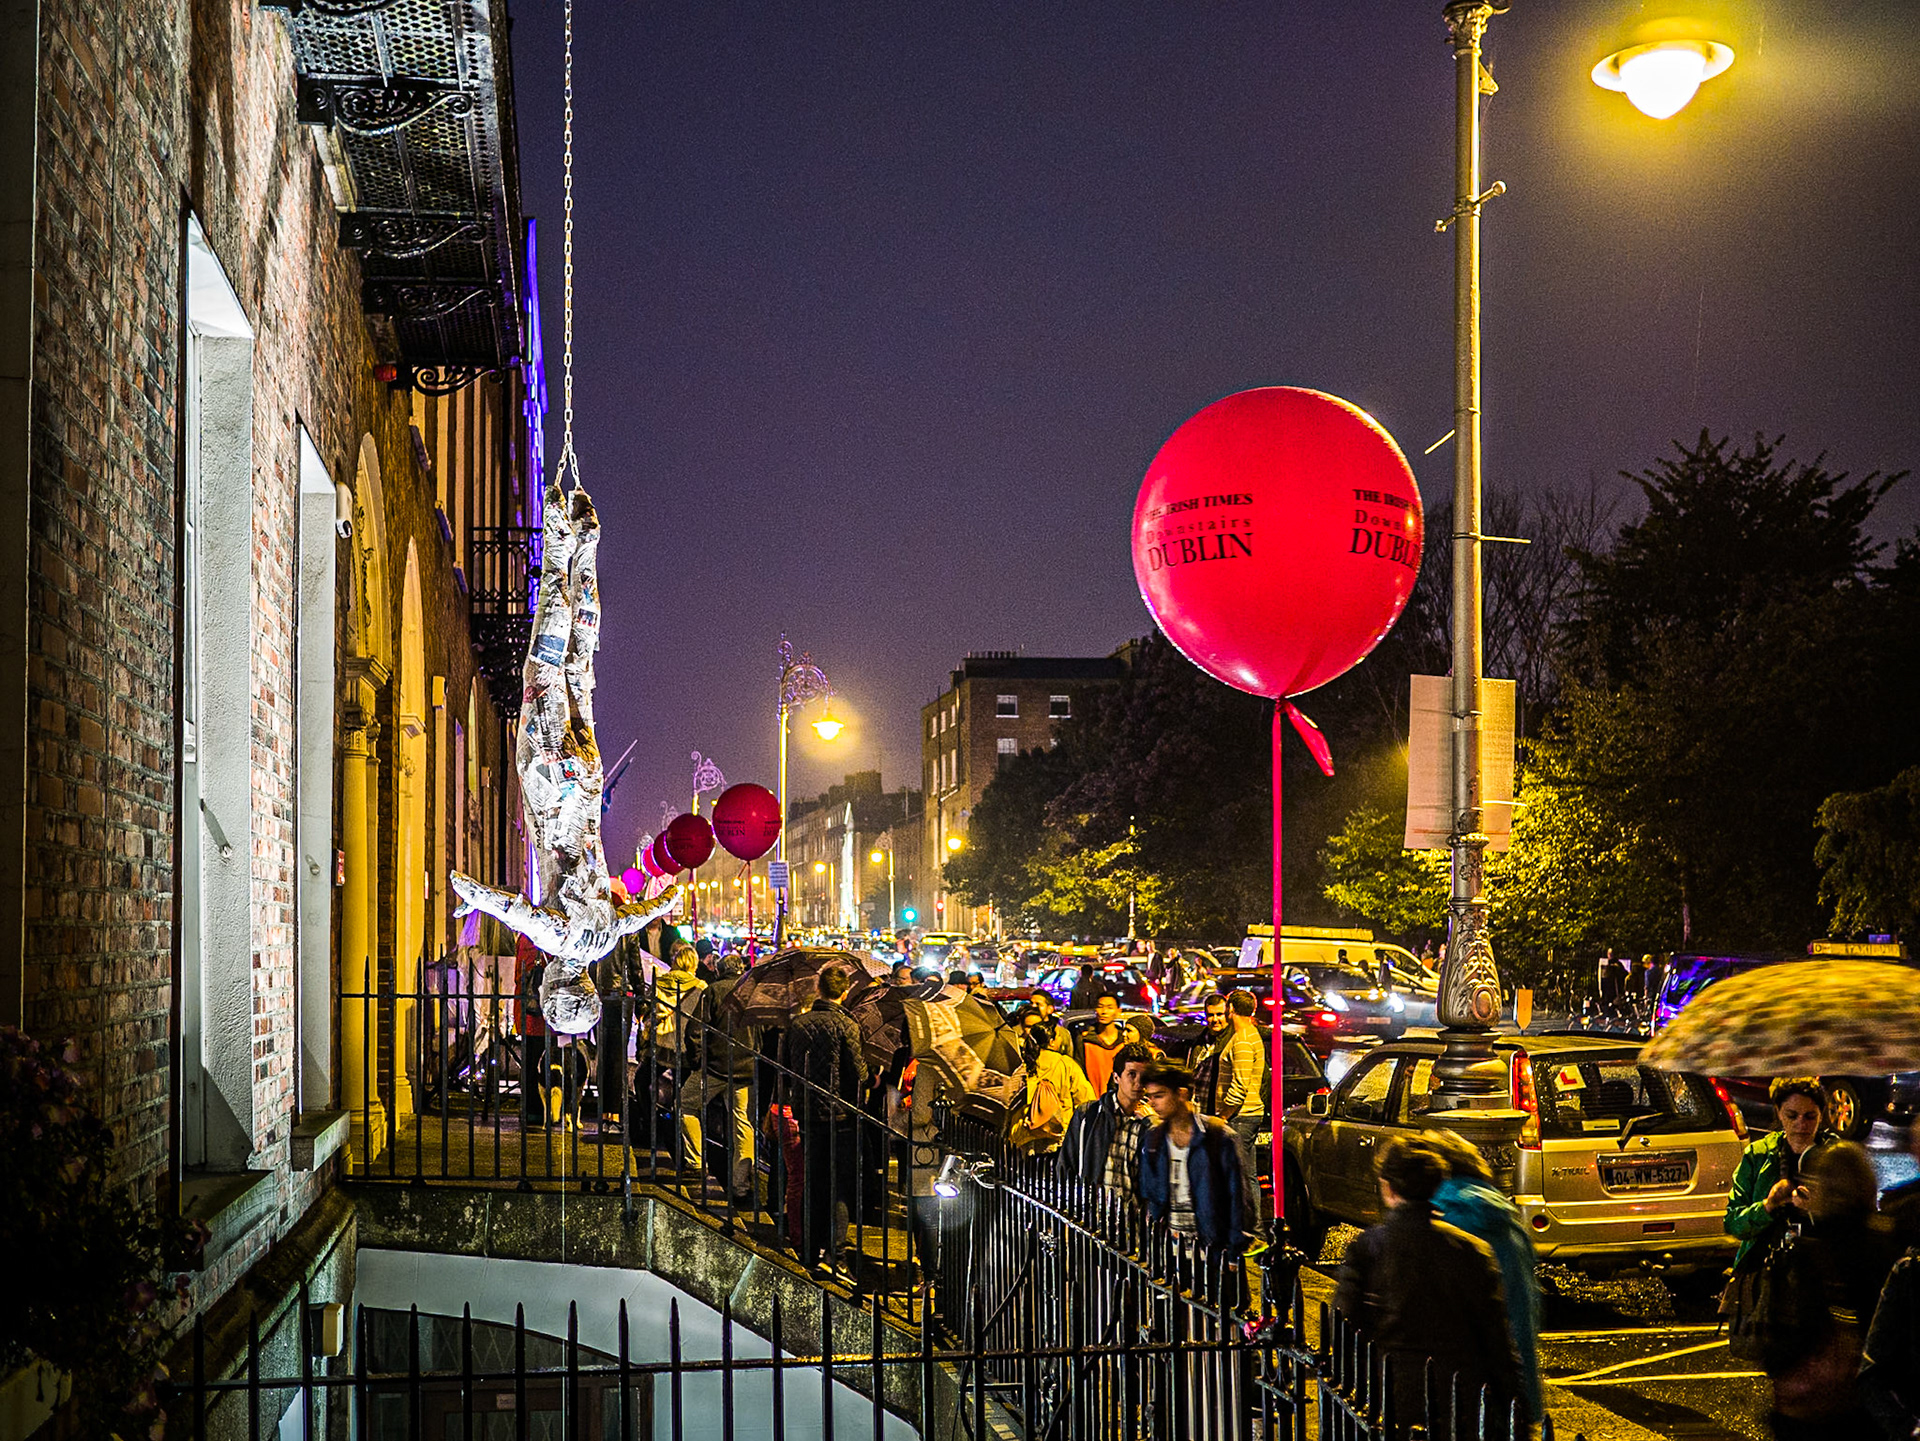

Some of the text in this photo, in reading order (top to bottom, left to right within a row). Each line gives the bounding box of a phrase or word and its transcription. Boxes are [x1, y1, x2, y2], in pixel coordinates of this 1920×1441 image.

[1203, 493, 1253, 508] TIMES
[1352, 489, 1382, 503] THE
[1148, 532, 1253, 571] DUBLIN
[1560, 1071, 1578, 1085] L
[1615, 1168, 1682, 1186] 04-WW-5327
